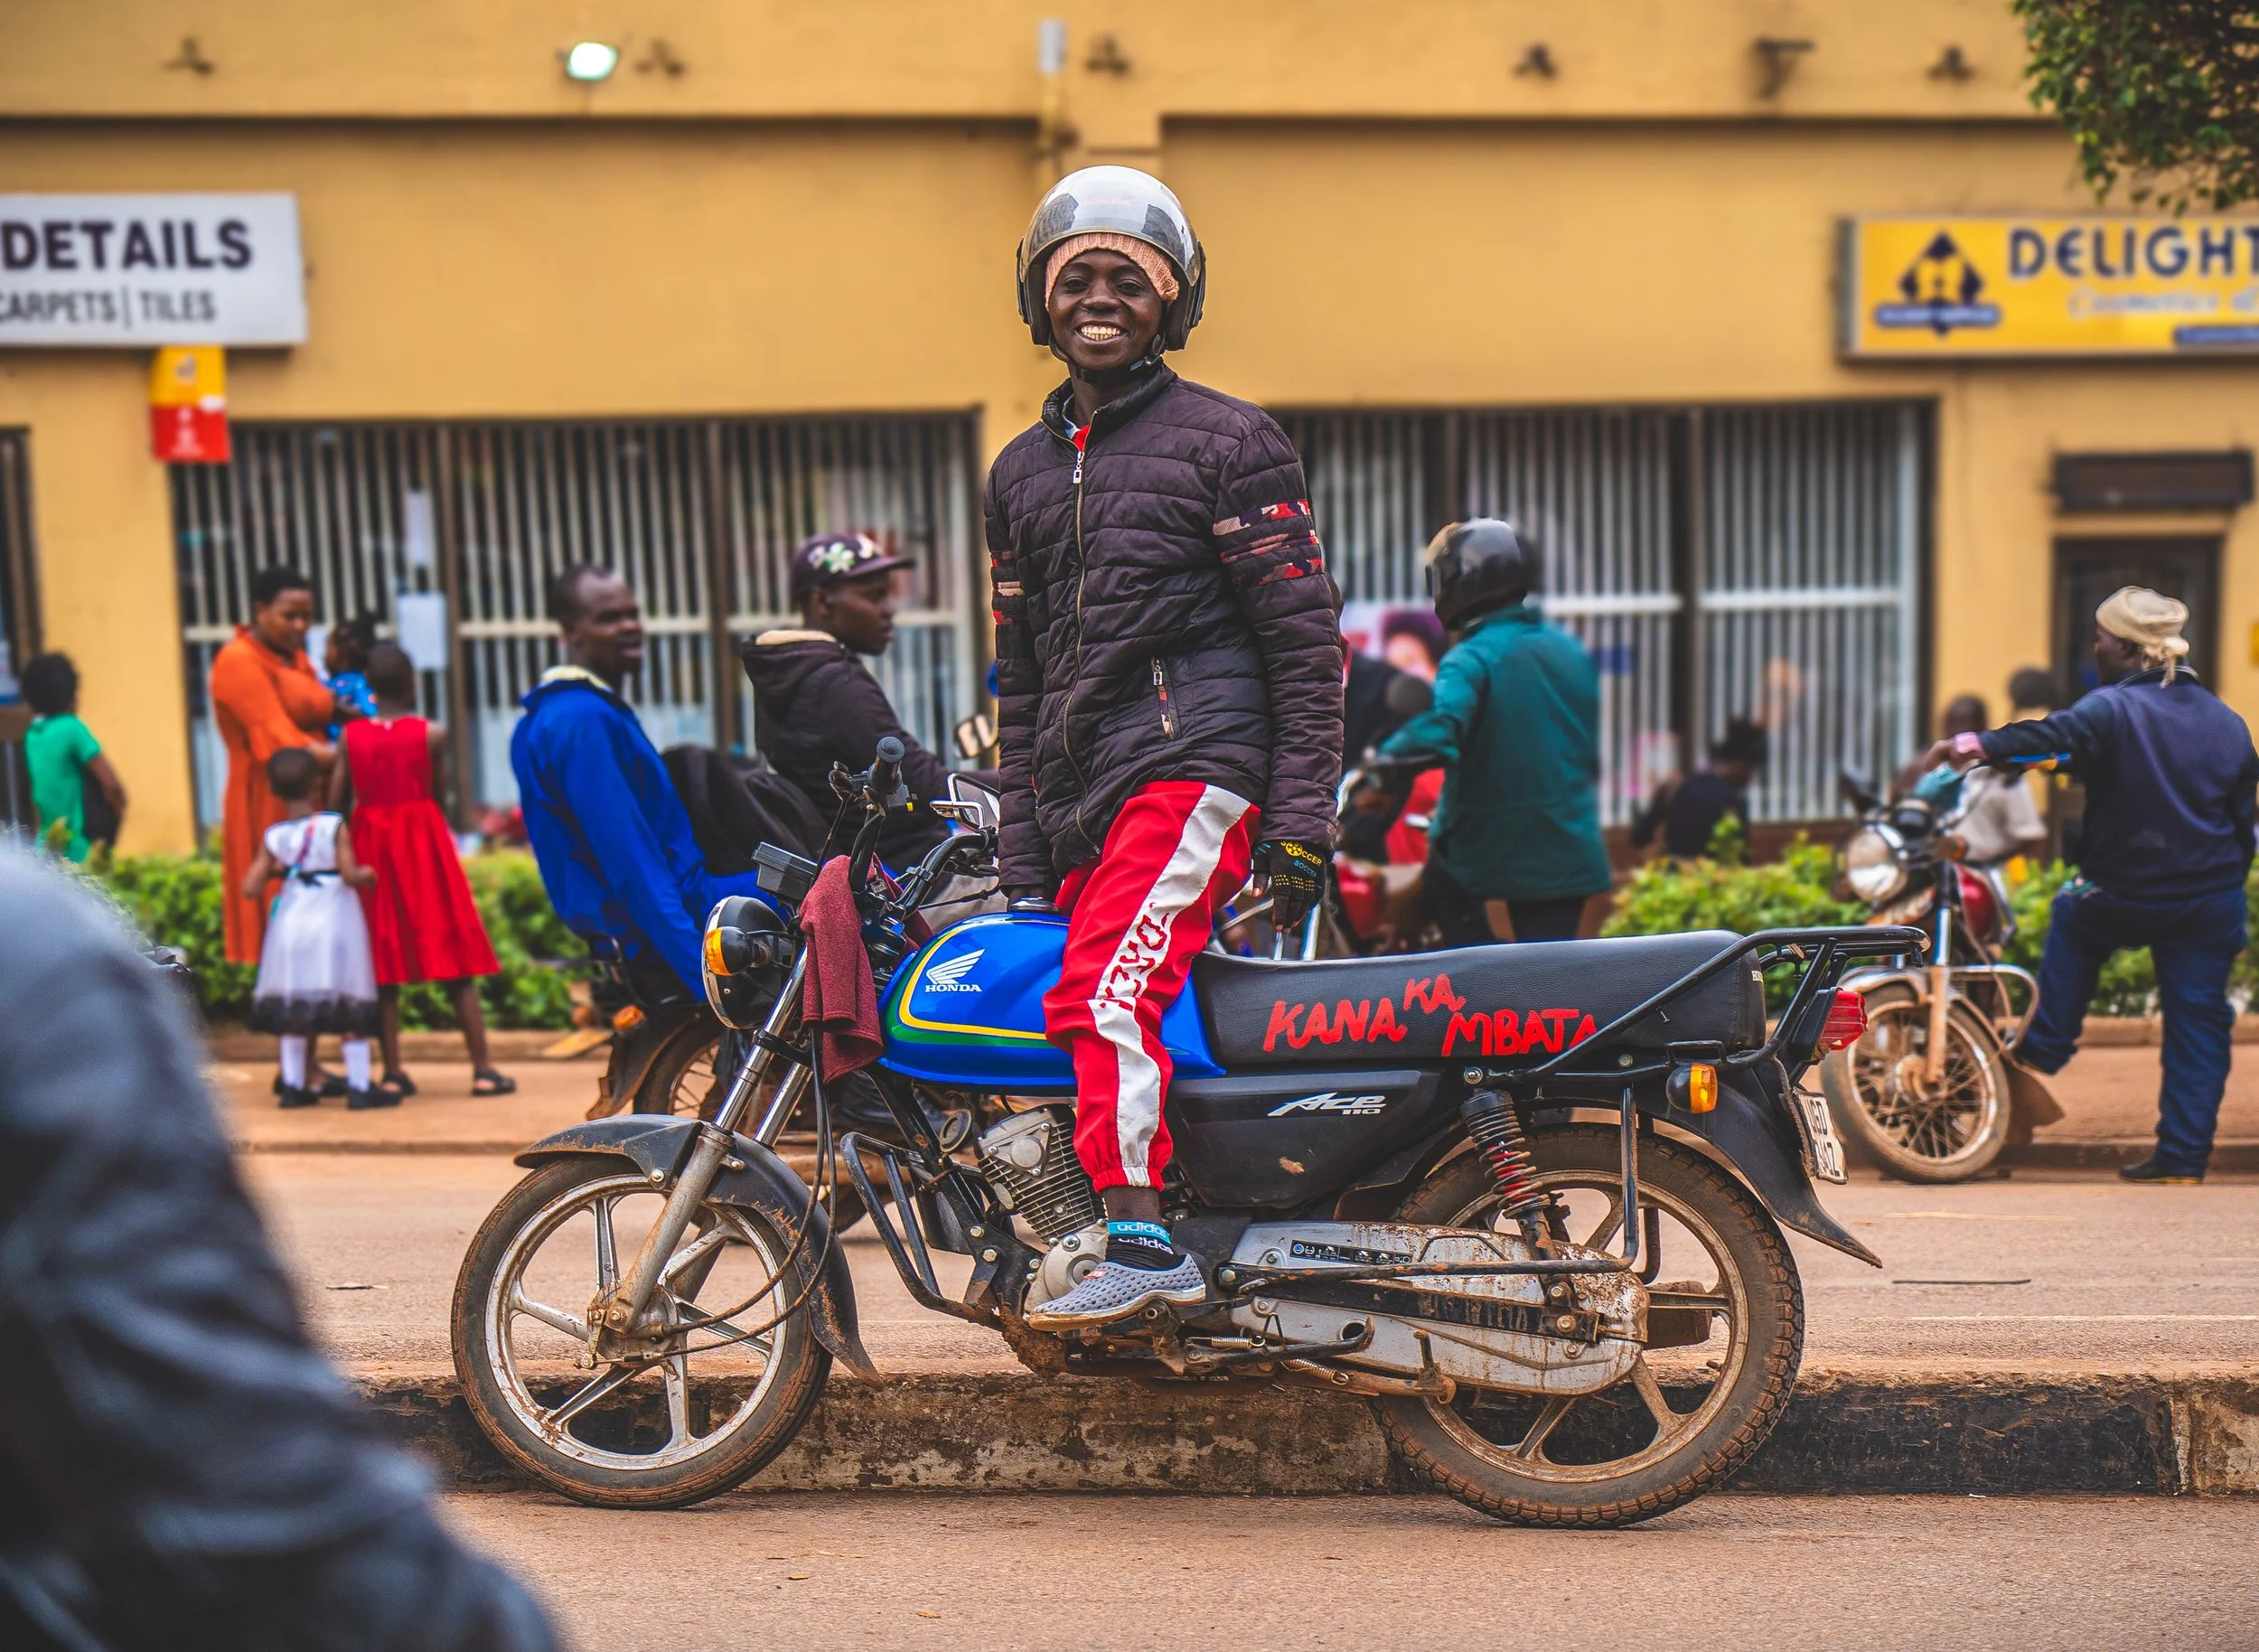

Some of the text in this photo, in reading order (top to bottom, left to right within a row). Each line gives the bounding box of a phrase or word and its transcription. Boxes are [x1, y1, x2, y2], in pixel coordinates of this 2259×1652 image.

[1, 220, 252, 270] DETAILS
[139, 291, 217, 323] TILES
[924, 983, 982, 993] HONDA
[1262, 973, 1598, 1056] KANA KA MBATA
[1267, 1092, 1387, 1117] Ace
[1117, 1221, 1167, 1238] adidas
